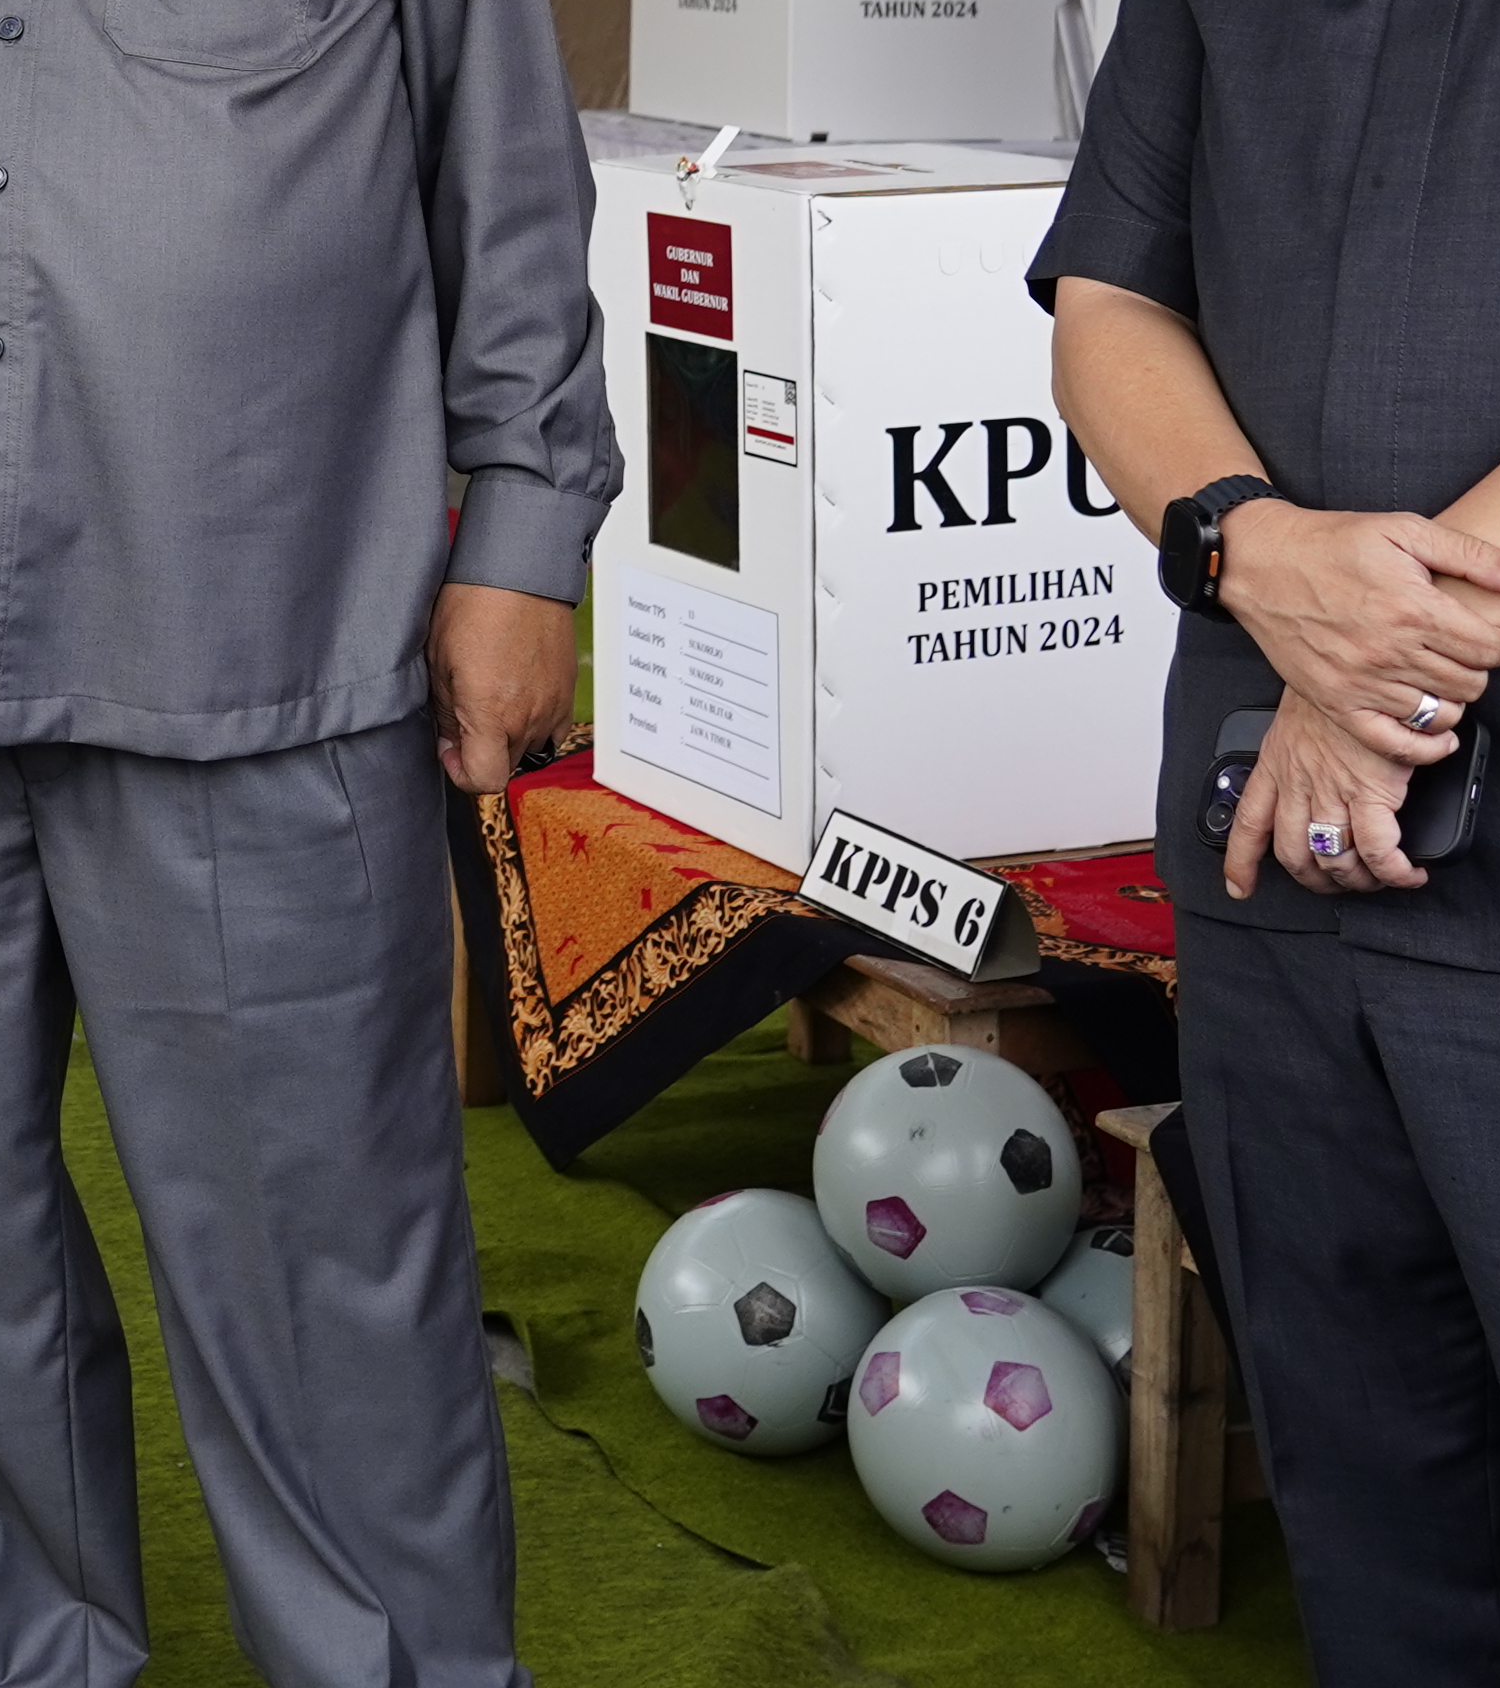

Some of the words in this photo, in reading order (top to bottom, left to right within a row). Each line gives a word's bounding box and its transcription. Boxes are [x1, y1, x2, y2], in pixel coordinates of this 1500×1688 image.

[860, 1, 926, 19] TAHUN
[931, 1, 979, 19] 2024
[665, 245, 714, 268] GUBERNUR
[680, 268, 700, 284] DAN
[652, 282, 681, 301] WAKIL
[681, 288, 729, 311] GUBERNUR
[917, 564, 1115, 613] PEMILIHAN
[907, 624, 1029, 665] TAHUN
[1038, 614, 1125, 652] 2024
[820, 835, 949, 929] KPPS
[954, 896, 986, 948] 6
